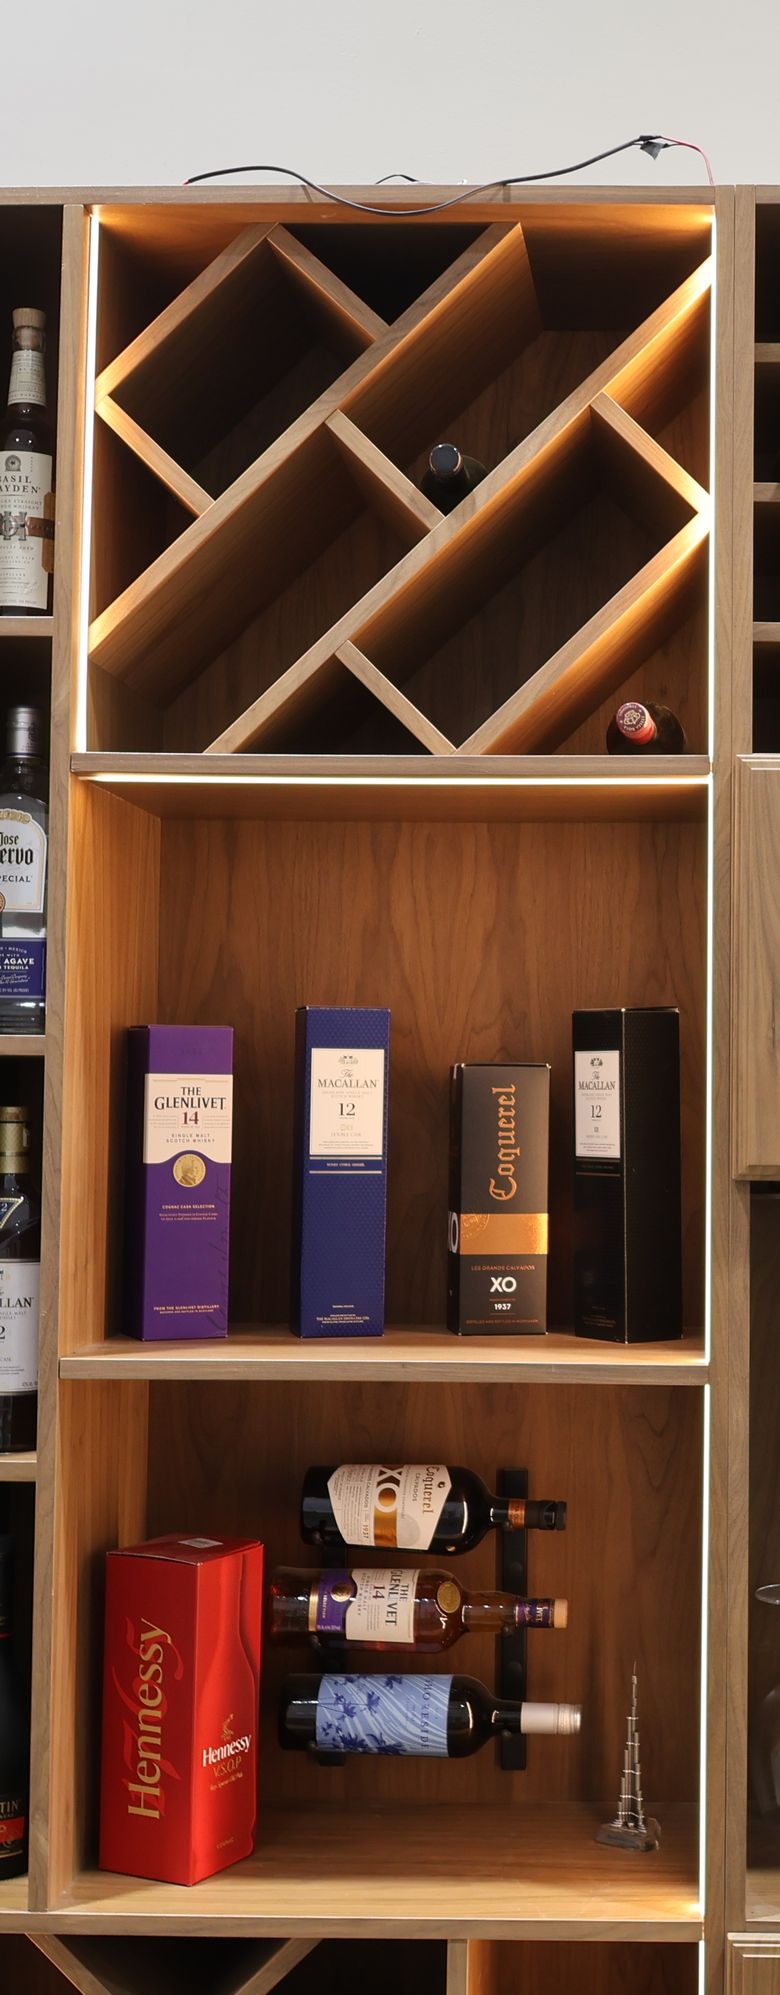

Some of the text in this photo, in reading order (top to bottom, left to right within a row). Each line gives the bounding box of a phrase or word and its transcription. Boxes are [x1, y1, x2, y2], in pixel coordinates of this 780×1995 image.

[0, 485, 38, 494] AYDEN
[0, 847, 34, 866] ervo
[4, 957, 35, 965] AGAVE
[339, 1069, 353, 1078] The
[181, 1086, 202, 1096] THE
[317, 1079, 377, 1089] MACALLAN
[578, 1081, 616, 1091] MACALLAN
[154, 1096, 227, 1111] GLENLIVET
[339, 1102, 356, 1116] 12
[182, 1111, 199, 1125] 14
[591, 1104, 602, 1118] 12
[488, 1084, 521, 1201] Coquerel
[489, 1277, 517, 1293] XO
[0, 1297, 32, 1308] LLAN
[494, 1303, 512, 1311] 1937
[0, 1325, 6, 1340] 2
[361, 1524, 370, 1540] 1937
[372, 1585, 386, 1600] 14
[385, 1569, 404, 1627] GLENLVET
[399, 1583, 410, 1602] THE
[128, 1616, 172, 1820] Hennessy
[202, 1734, 252, 1768] Hennessy
[0, 1800, 18, 1813] TIN
